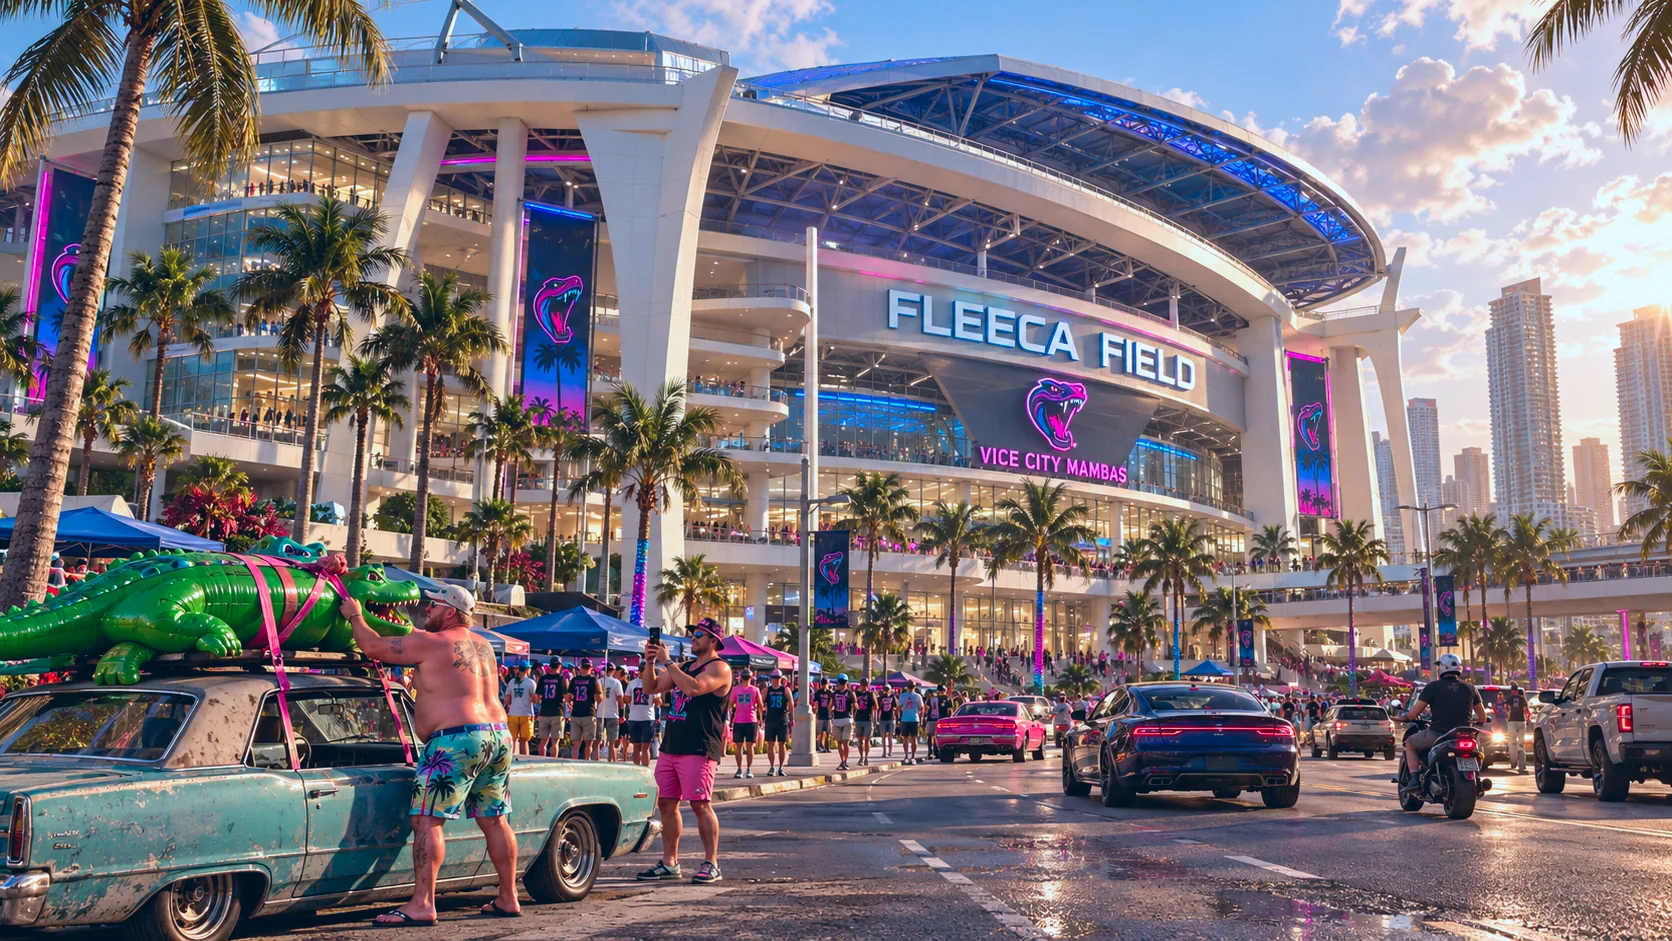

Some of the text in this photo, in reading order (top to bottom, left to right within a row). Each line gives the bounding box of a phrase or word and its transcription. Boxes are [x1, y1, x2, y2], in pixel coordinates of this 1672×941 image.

[888, 289, 1195, 391] FLEECA FIELD
[979, 446, 1127, 484] VICE CITY MAMBAS
[544, 684, 556, 699] 13
[575, 686, 587, 701] 13
